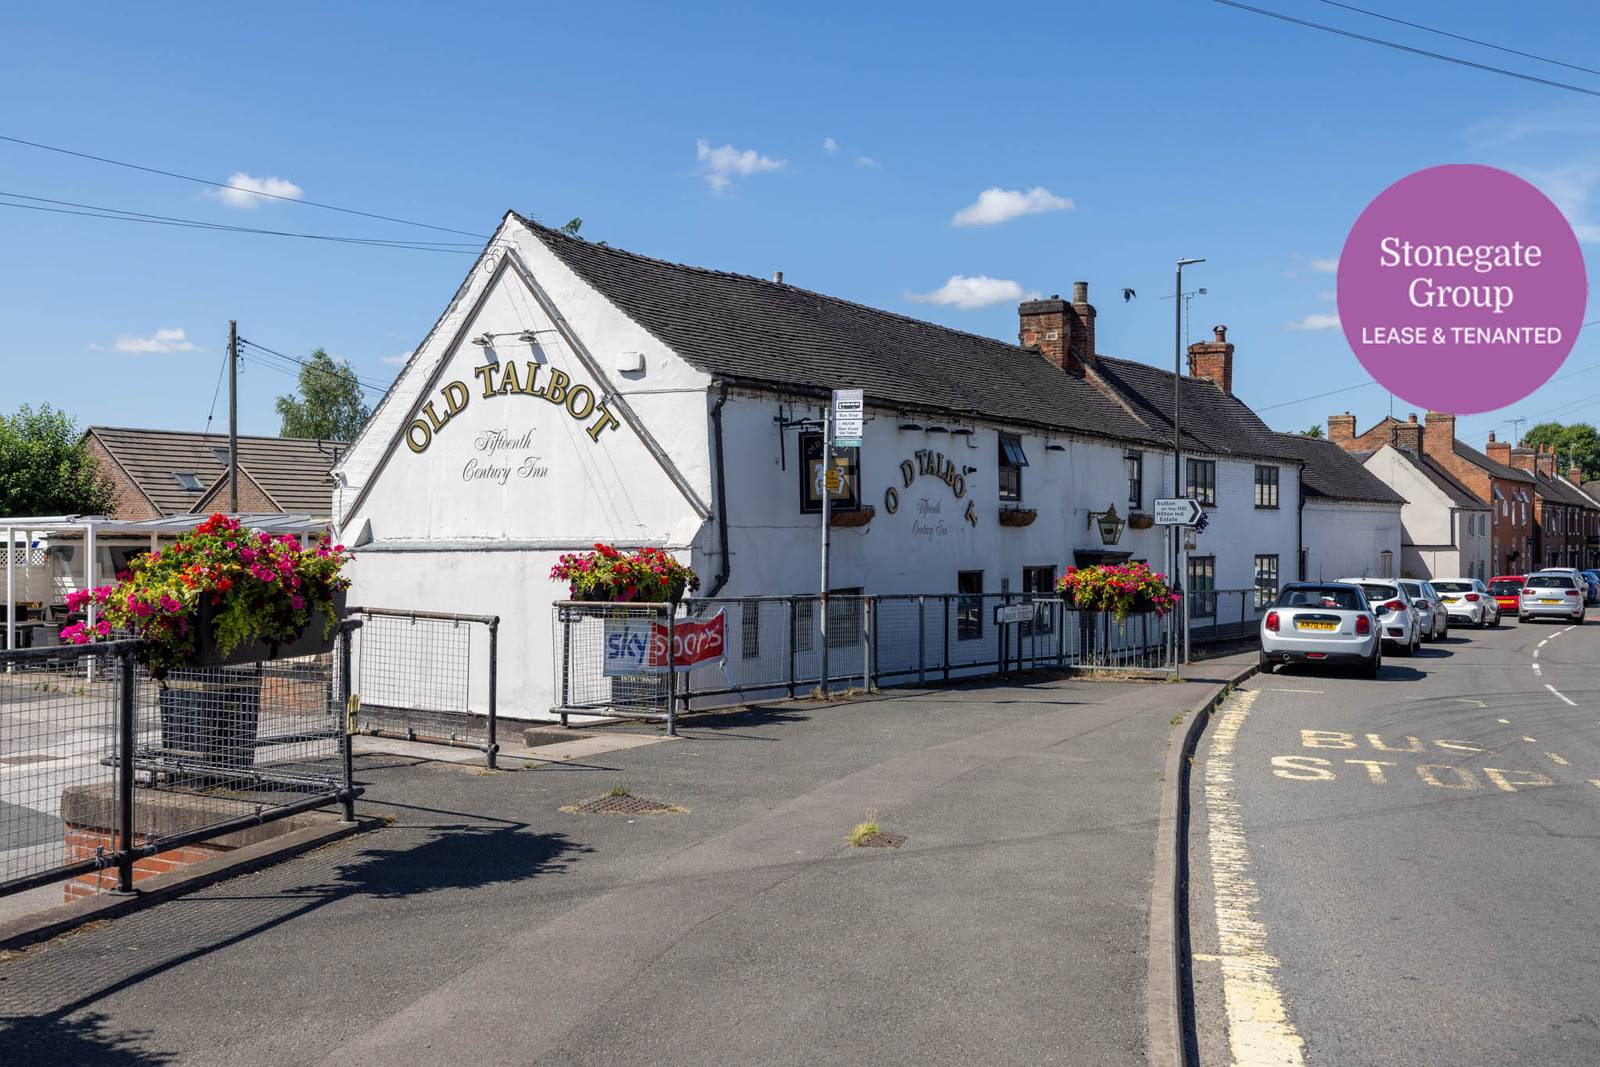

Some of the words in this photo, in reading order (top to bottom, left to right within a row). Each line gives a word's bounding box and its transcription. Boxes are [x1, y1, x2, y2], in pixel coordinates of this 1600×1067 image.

[405, 380, 470, 453] OLD
[474, 360, 621, 443] TALBOT
[474, 427, 537, 456] Fifteenth
[462, 457, 512, 485] Century
[517, 456, 549, 478] Inn
[608, 626, 648, 664] sky
[1300, 729, 1490, 755] BUS
[1270, 755, 1553, 793] STOP
